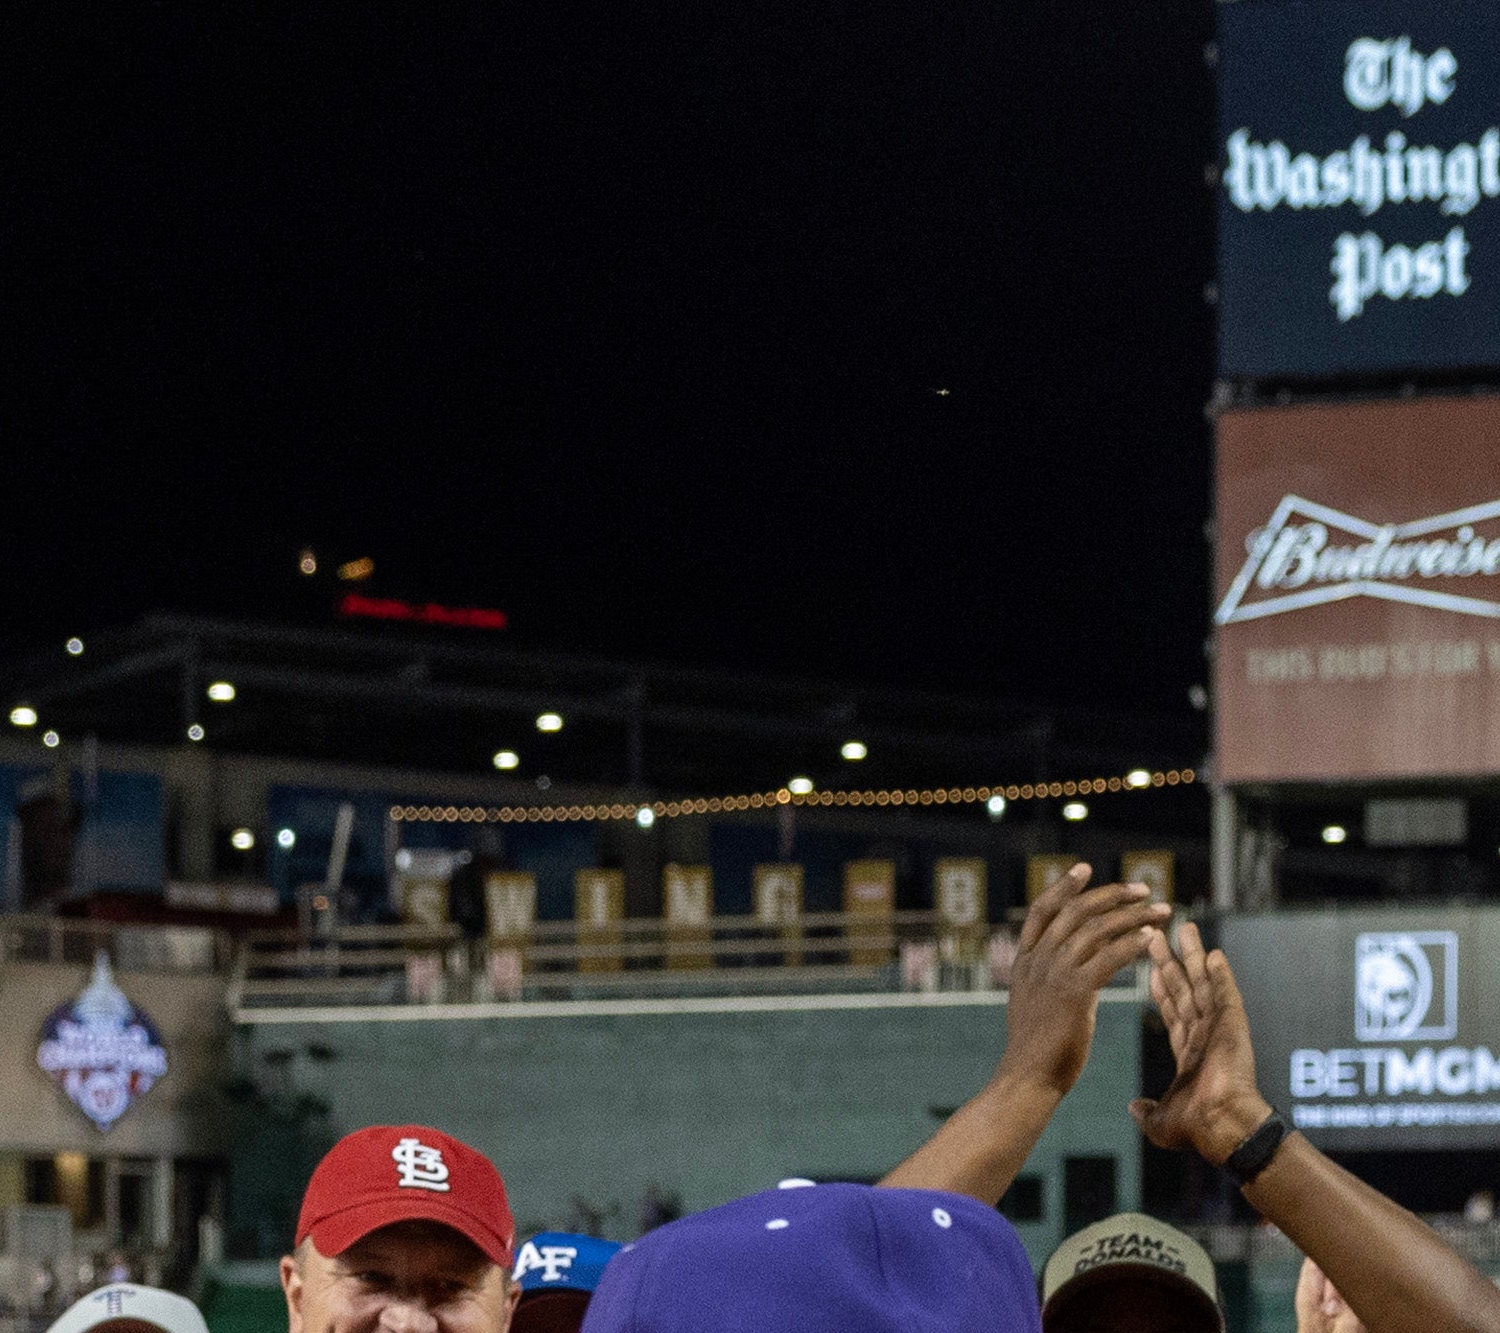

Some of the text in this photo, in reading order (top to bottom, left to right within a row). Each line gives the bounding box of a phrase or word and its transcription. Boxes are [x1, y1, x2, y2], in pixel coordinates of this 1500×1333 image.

[1342, 36, 1458, 115] The
[1330, 226, 1471, 321] Post
[511, 1241, 577, 1283] AF
[1074, 1245, 1187, 1275] DONALDS
